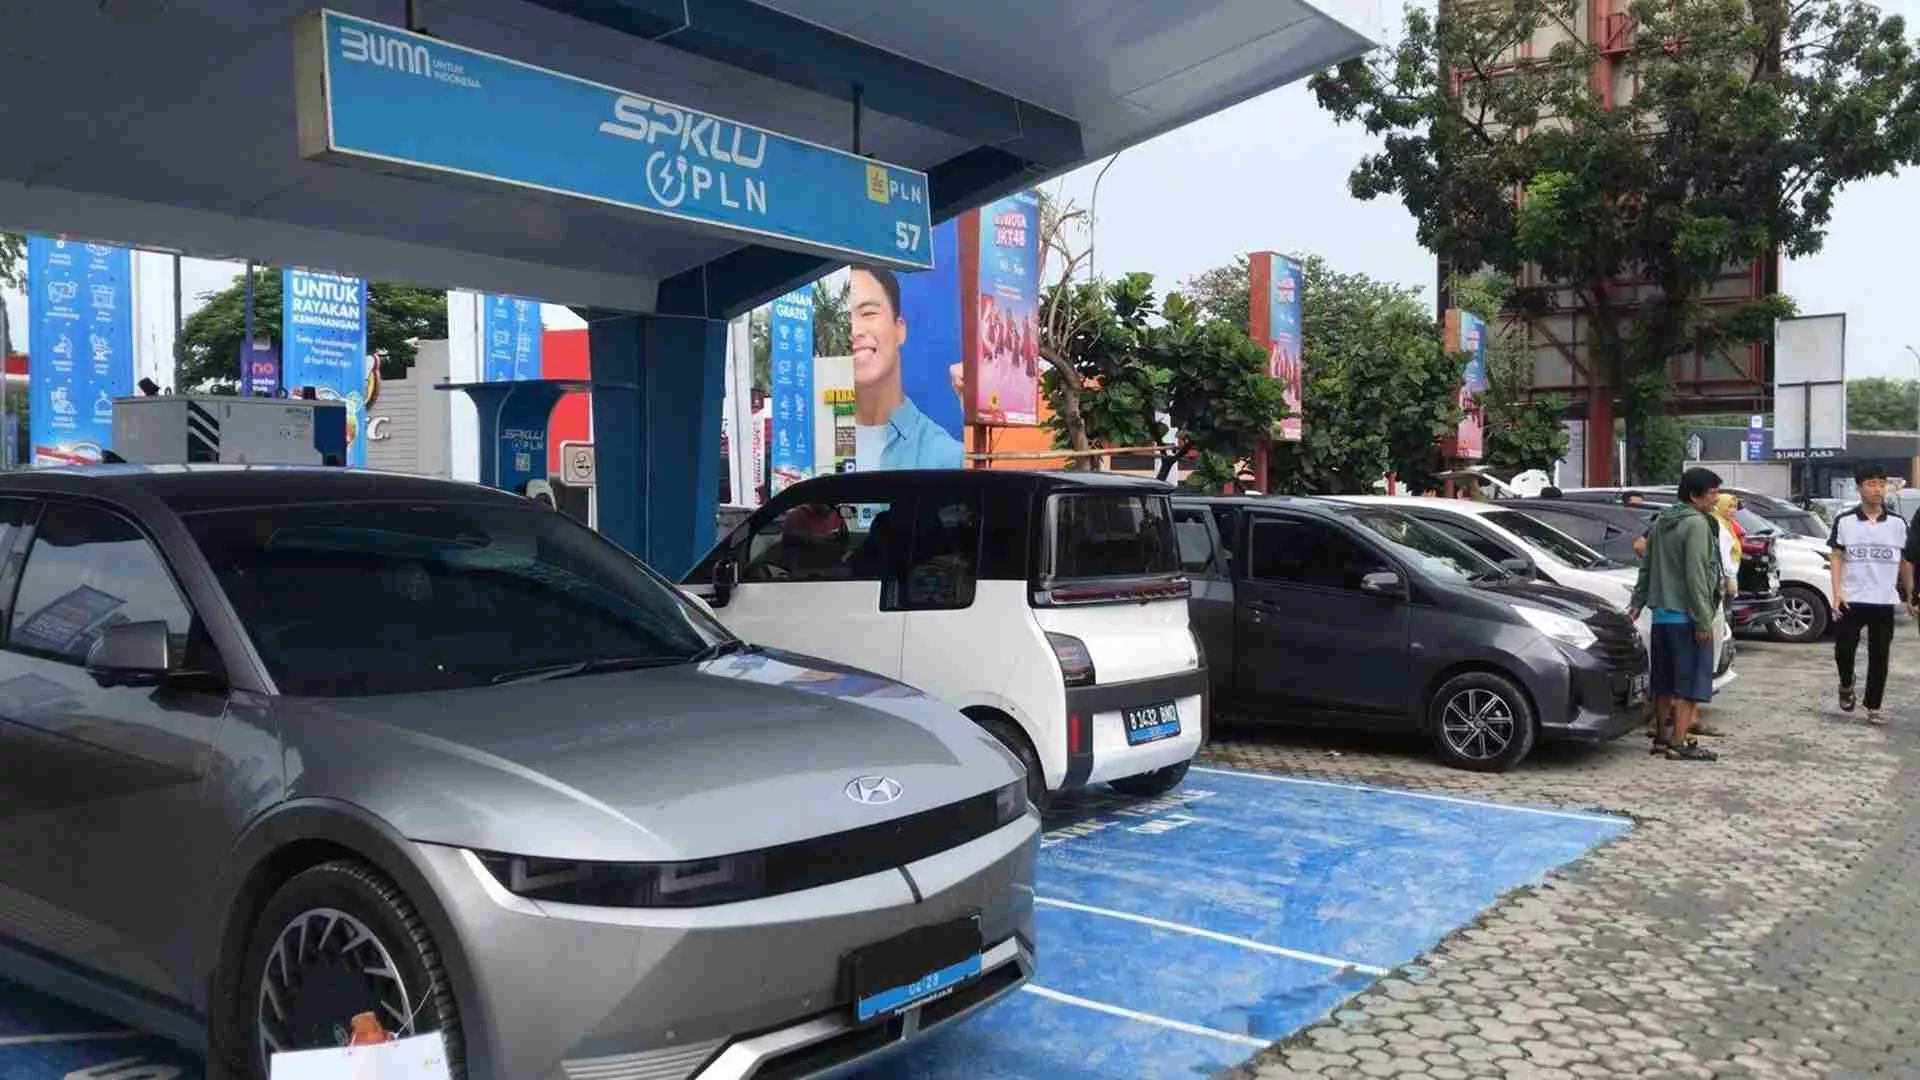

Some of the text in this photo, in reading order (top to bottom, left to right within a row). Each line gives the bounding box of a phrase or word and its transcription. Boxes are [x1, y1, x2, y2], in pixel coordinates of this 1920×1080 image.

[600, 95, 767, 168] SPKLU
[692, 165, 767, 215] PLN
[292, 278, 359, 304] UNTUK
[293, 297, 360, 319] RAYAKAN
